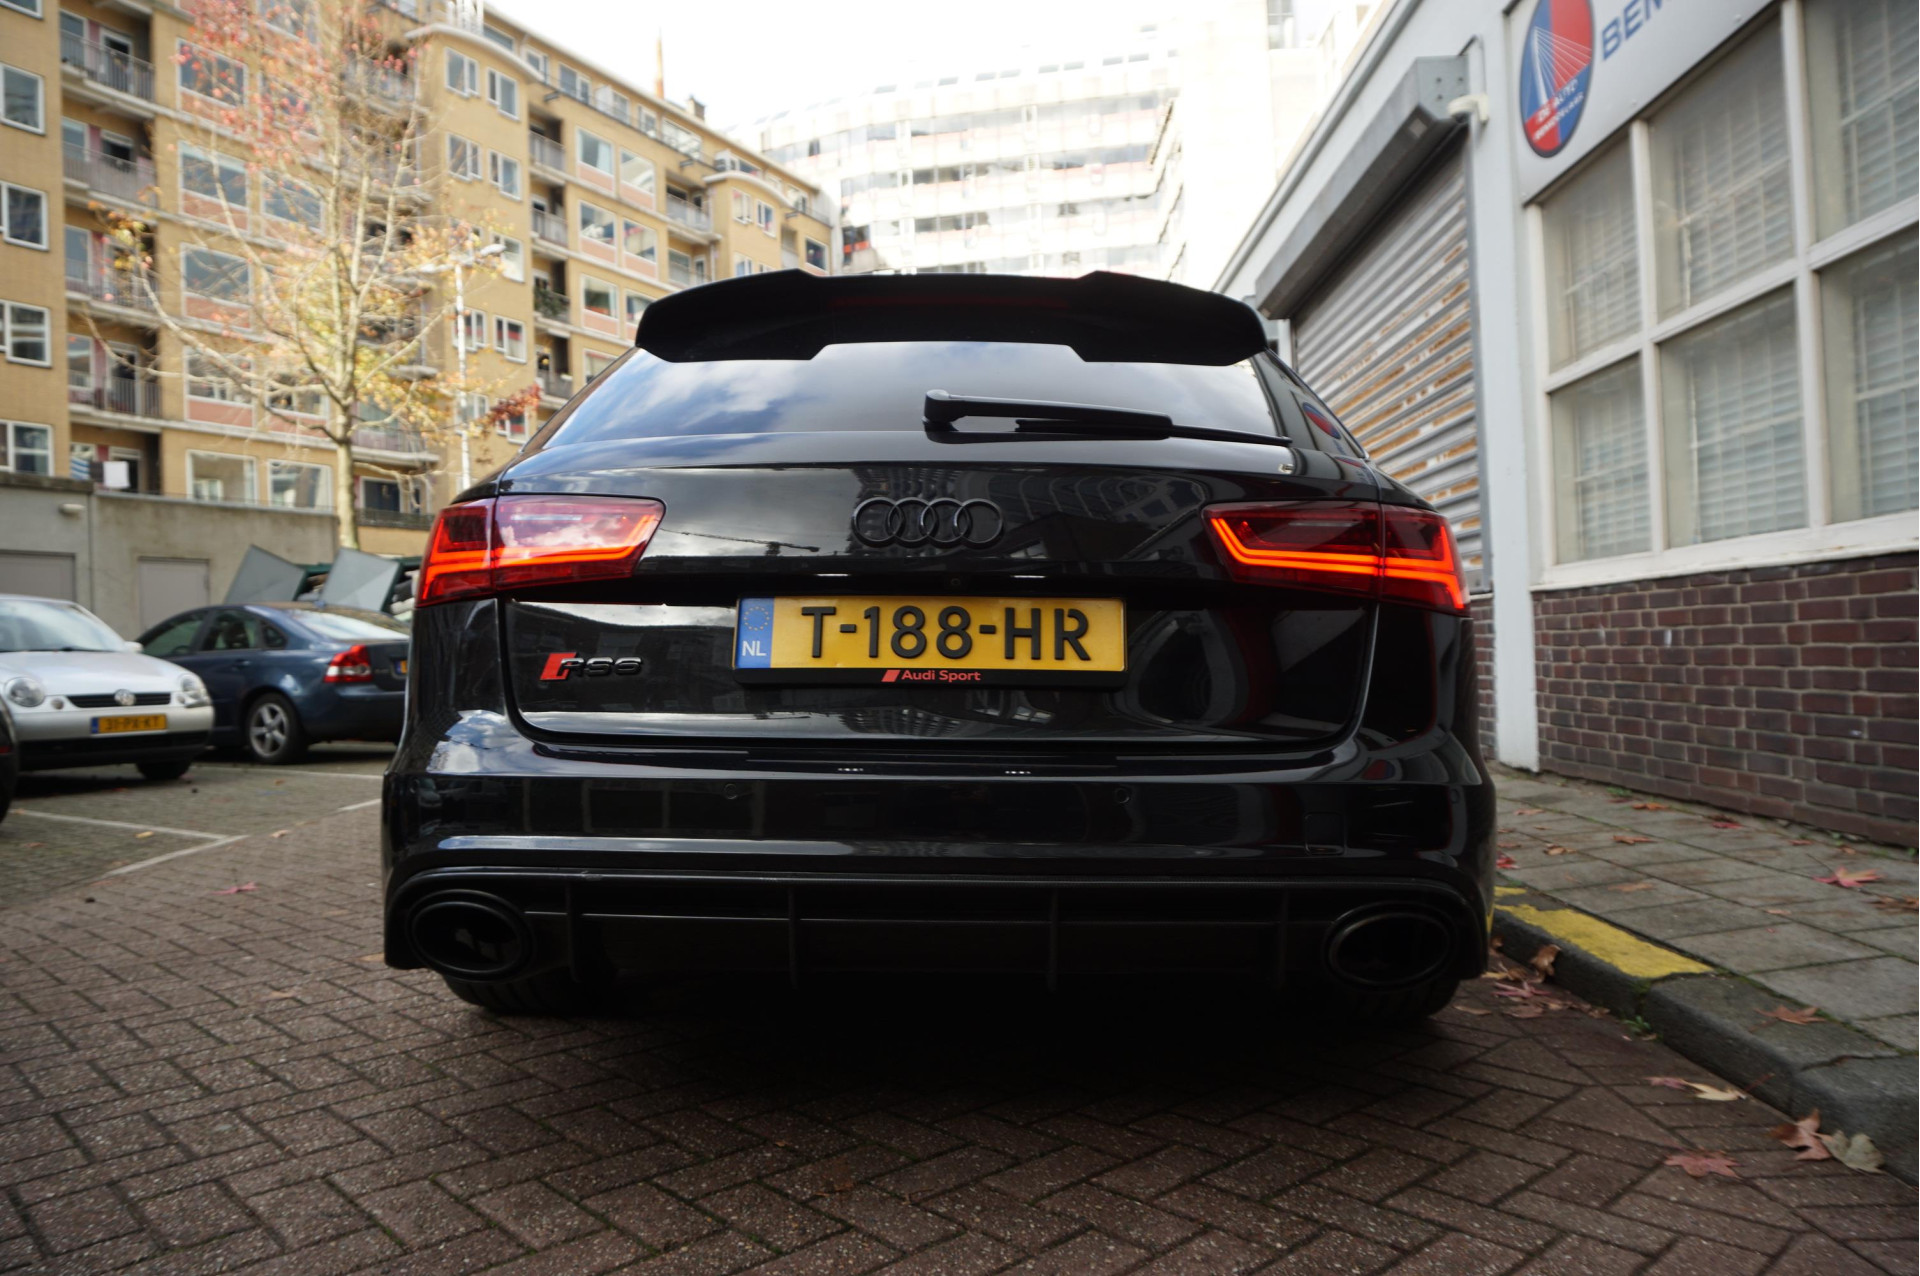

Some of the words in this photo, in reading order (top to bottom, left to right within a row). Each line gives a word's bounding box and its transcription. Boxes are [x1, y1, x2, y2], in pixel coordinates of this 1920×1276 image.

[801, 605, 1091, 661] T-188-HR
[742, 640, 767, 657] NL
[556, 656, 643, 677] RS6
[901, 669, 935, 681] Audi
[939, 669, 981, 683] Sport
